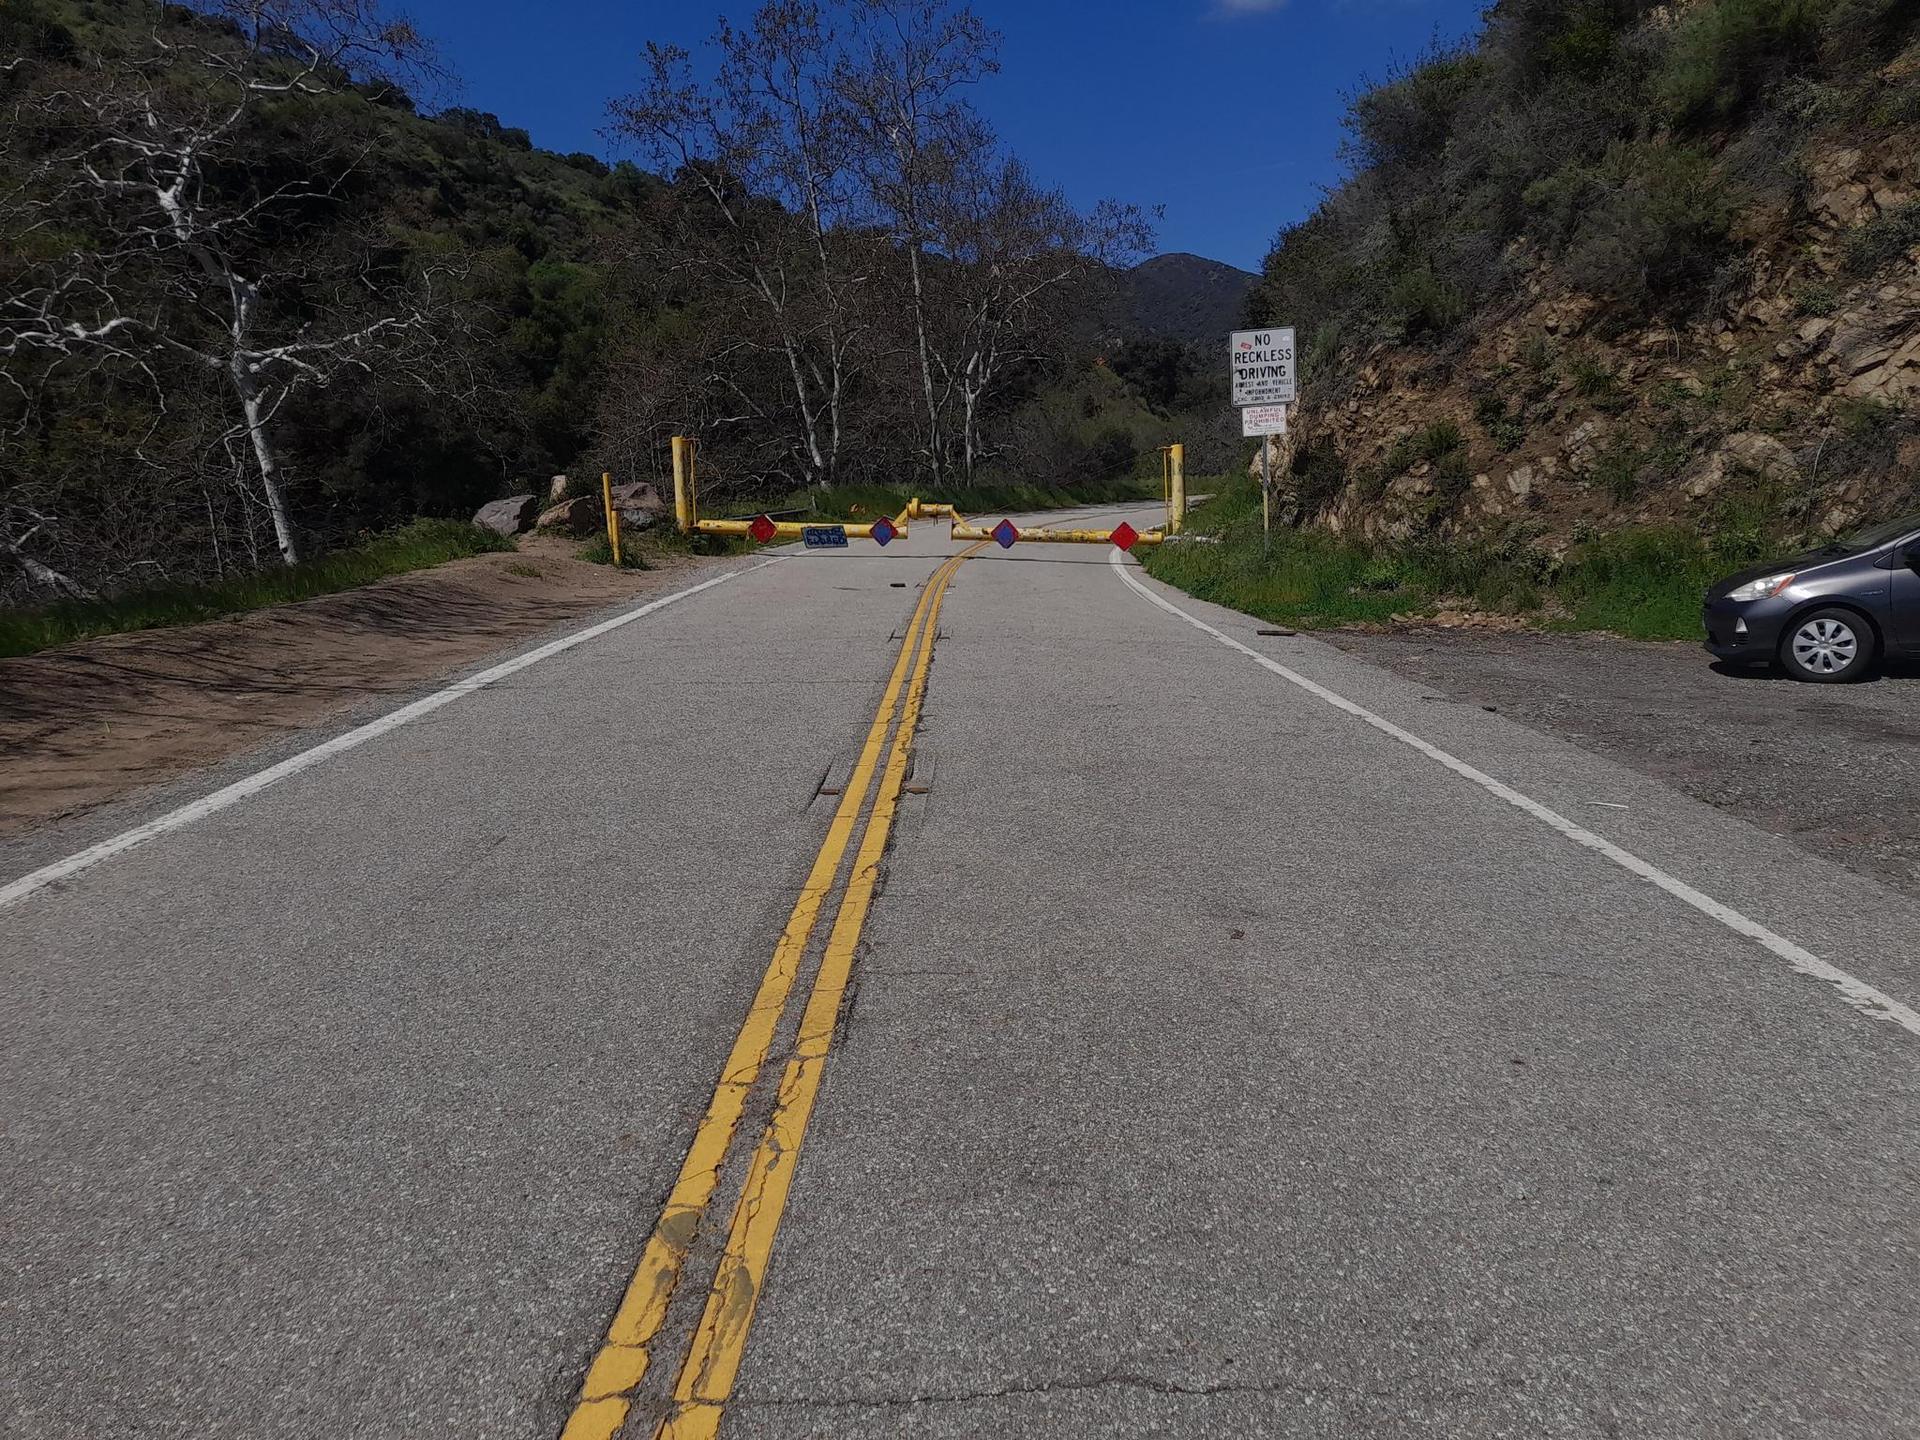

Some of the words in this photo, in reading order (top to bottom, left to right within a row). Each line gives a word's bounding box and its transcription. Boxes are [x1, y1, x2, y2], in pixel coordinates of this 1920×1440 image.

[1255, 333, 1271, 346] NO
[1234, 348, 1292, 364] RECKLESS
[1240, 365, 1286, 380] DRIVING
[1235, 381, 1254, 389] AREST
[1272, 378, 1292, 386] VEHICLE
[1245, 416, 1285, 424] PROHIBITED
